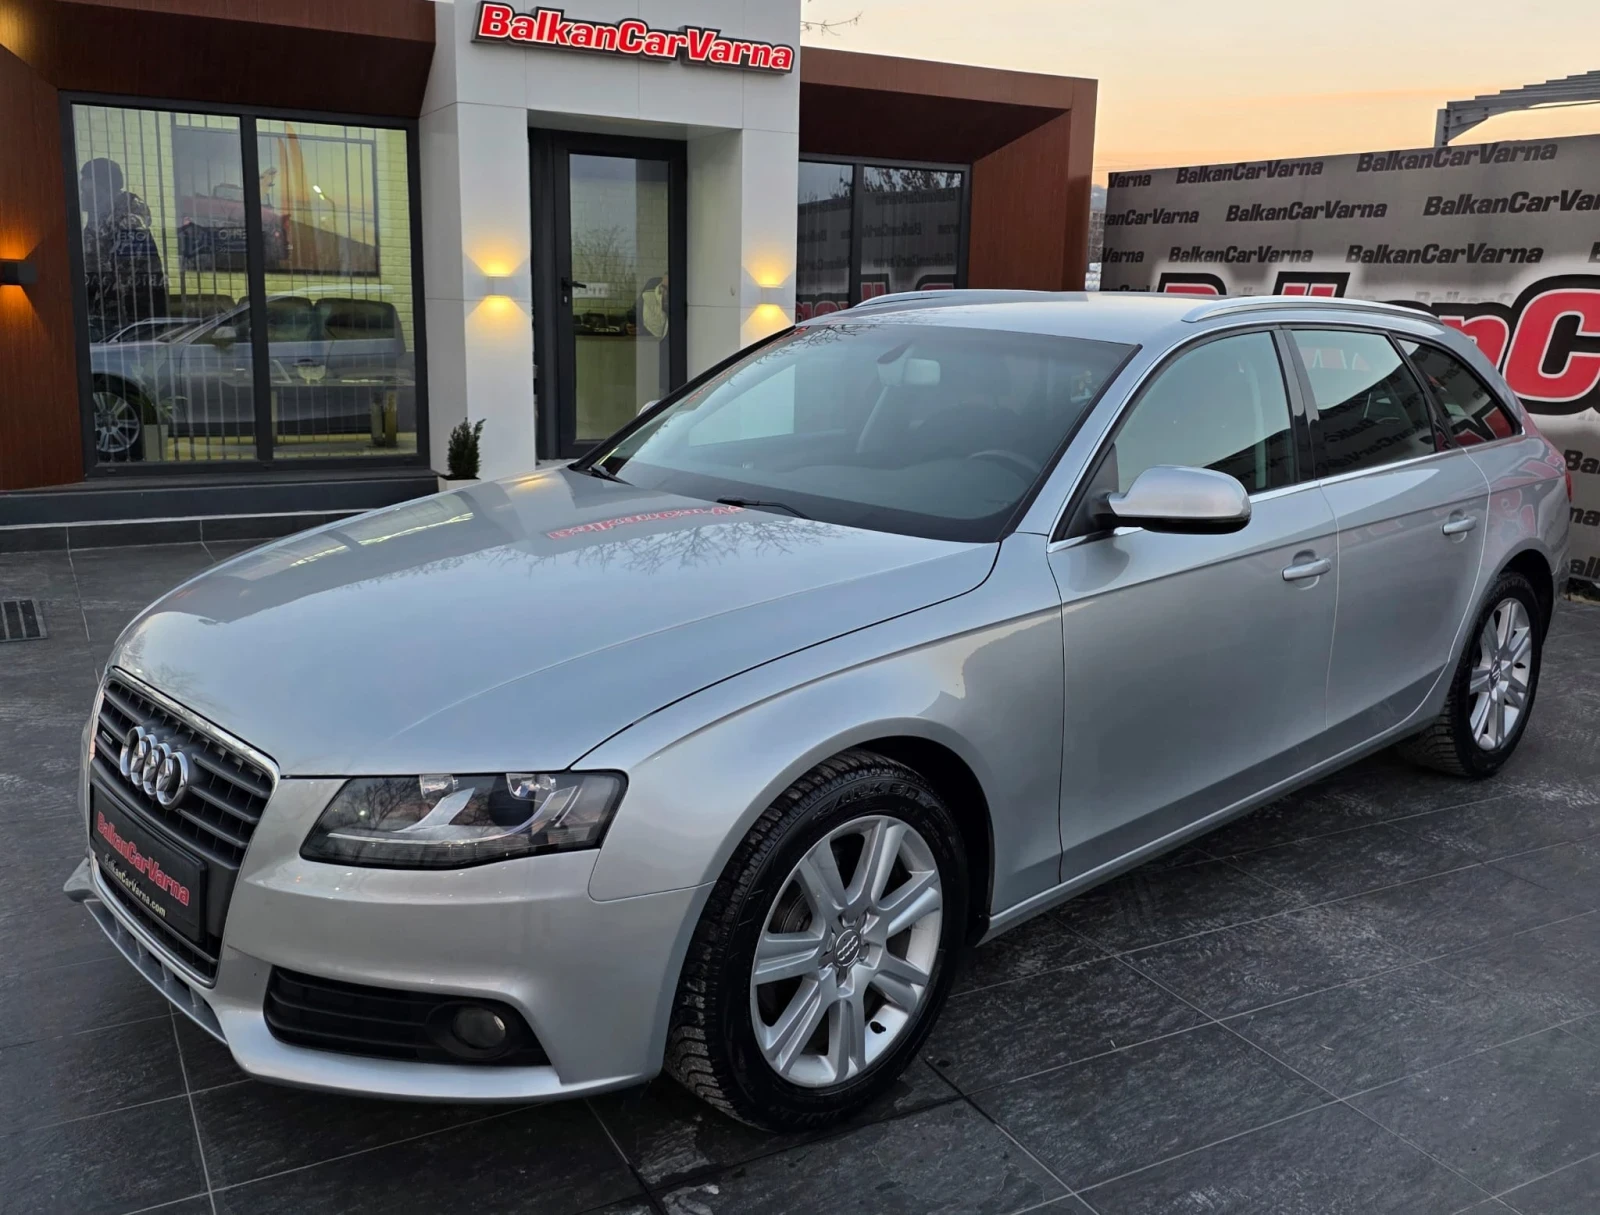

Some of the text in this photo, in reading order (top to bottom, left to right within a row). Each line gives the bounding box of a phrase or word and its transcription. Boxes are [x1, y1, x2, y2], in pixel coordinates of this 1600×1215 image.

[477, 2, 795, 71] BalkanCarVarna
[1356, 143, 1558, 173] BalkanCarVarna
[1176, 160, 1324, 184] BalkanCarVarna
[1225, 200, 1387, 223] BalkanCarVarna
[1168, 245, 1314, 263] BalkanCarVarna
[1345, 243, 1544, 264] BalkanCarVarna
[97, 811, 190, 907] BalkanCarVarna
